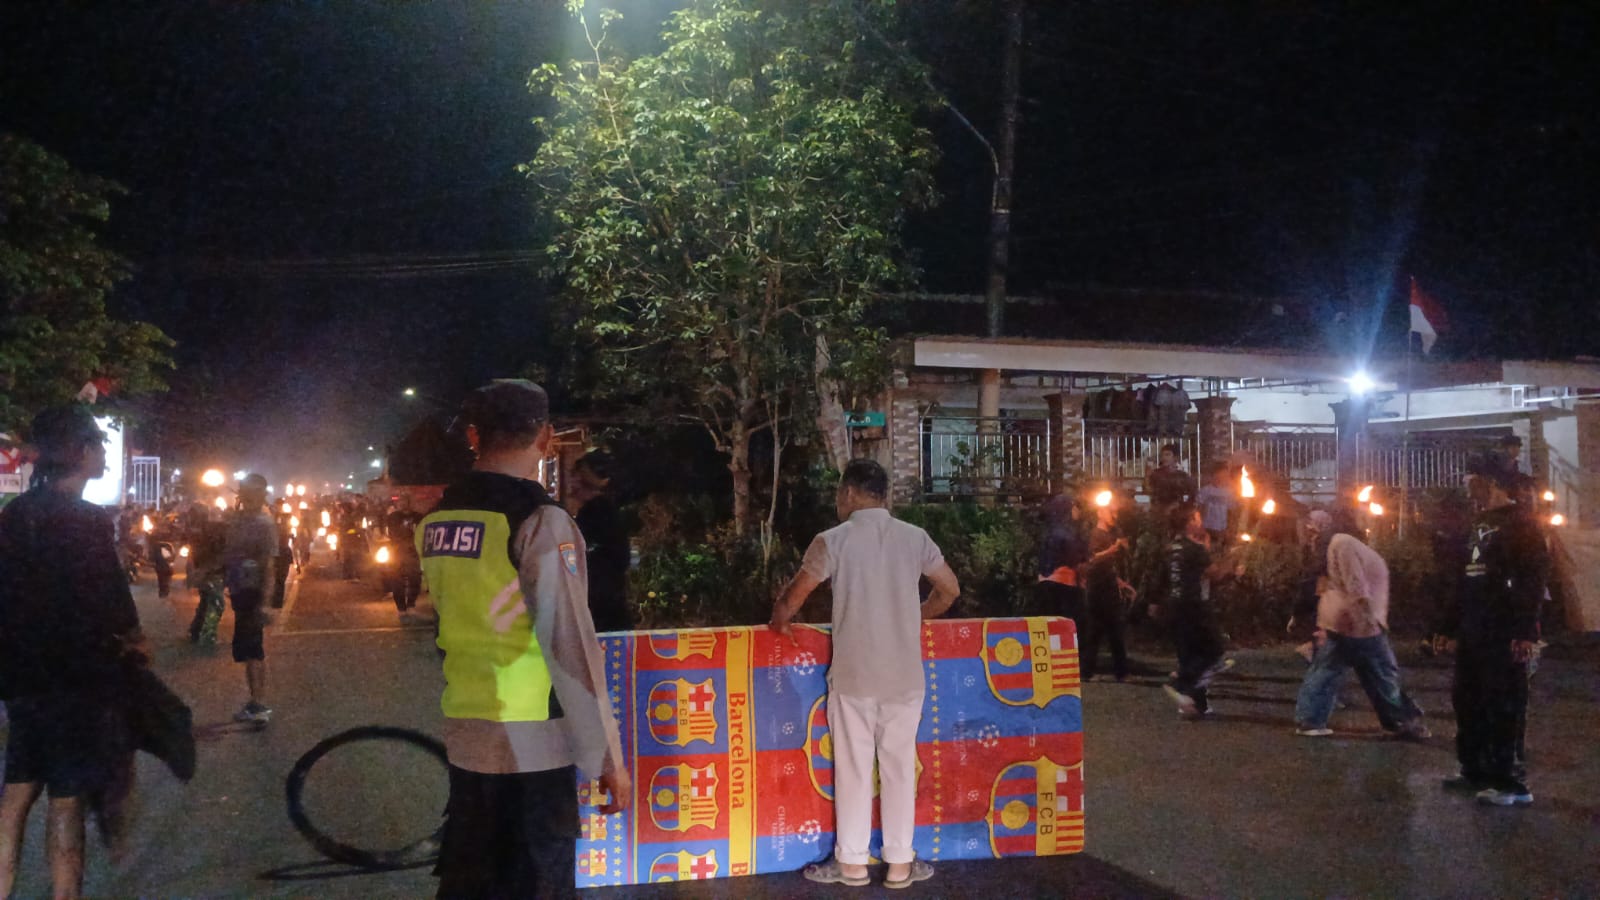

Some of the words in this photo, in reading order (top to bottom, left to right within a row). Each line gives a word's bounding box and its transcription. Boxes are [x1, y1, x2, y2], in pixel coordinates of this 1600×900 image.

[1032, 630, 1048, 673] FCB
[679, 698, 688, 726] FCB
[729, 692, 749, 809] Barcelona
[680, 784, 690, 812] FCB
[1040, 792, 1054, 836] FCB
